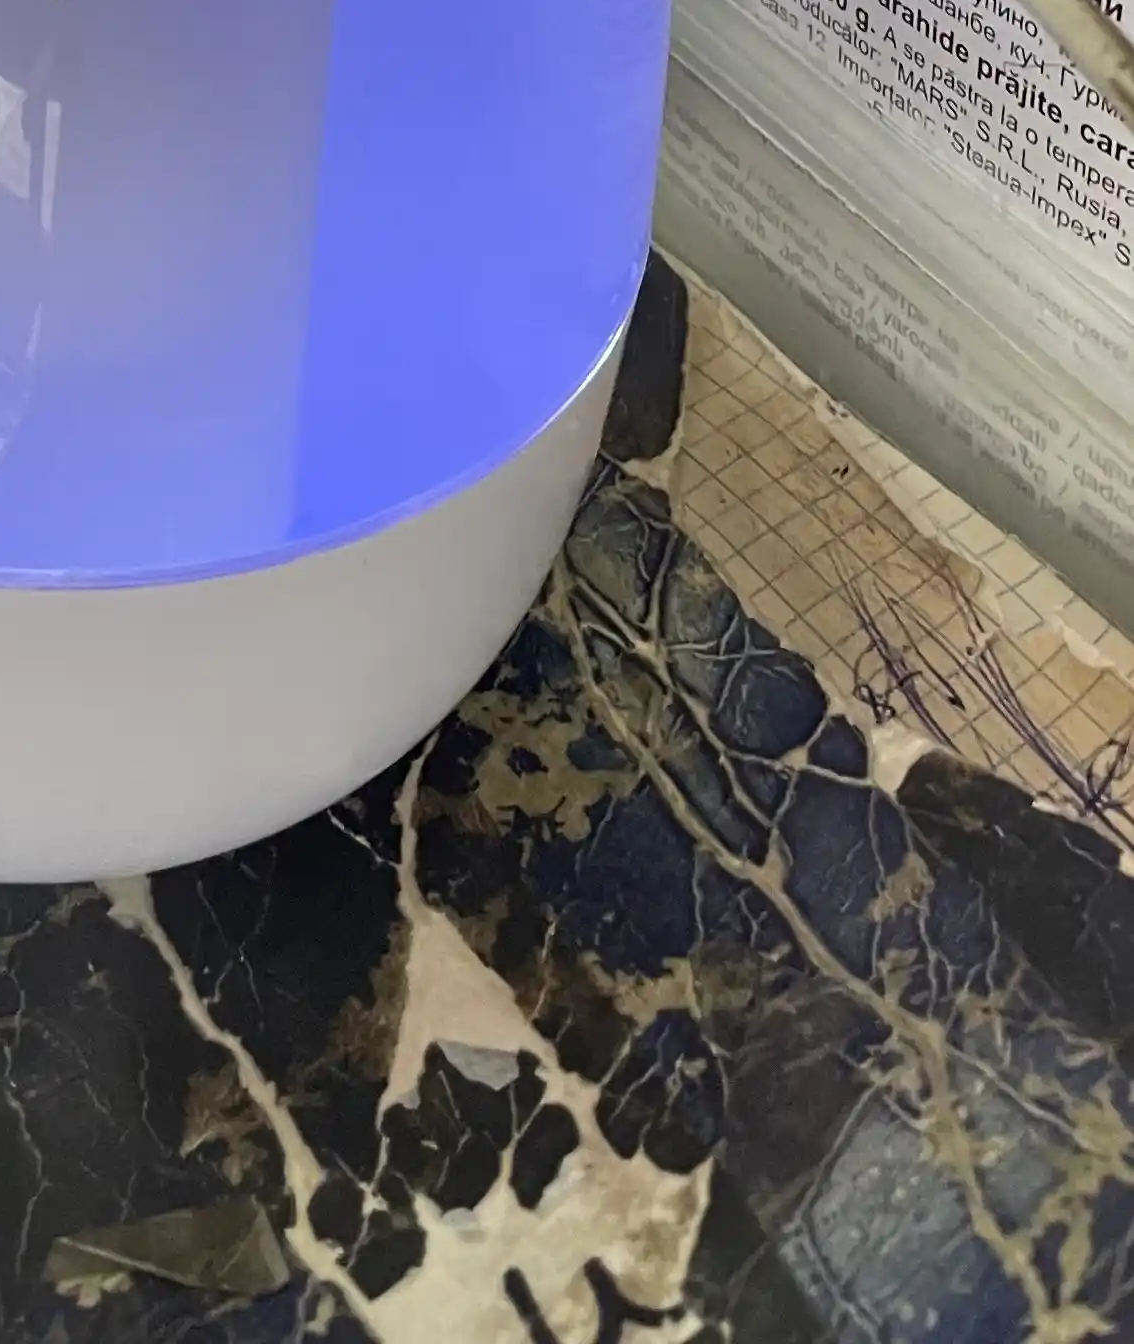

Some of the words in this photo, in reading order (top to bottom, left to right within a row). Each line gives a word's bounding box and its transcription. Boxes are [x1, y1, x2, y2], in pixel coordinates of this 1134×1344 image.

[856, 7, 875, 34] g.
[883, 27, 897, 50] A
[903, 43, 925, 69] se
[932, 63, 993, 117] păstra
[1001, 104, 1018, 133] la
[977, 56, 1069, 135] prăjite,
[1009, 41, 1050, 80] куч.
[1057, 173, 1126, 237] Rusia,
